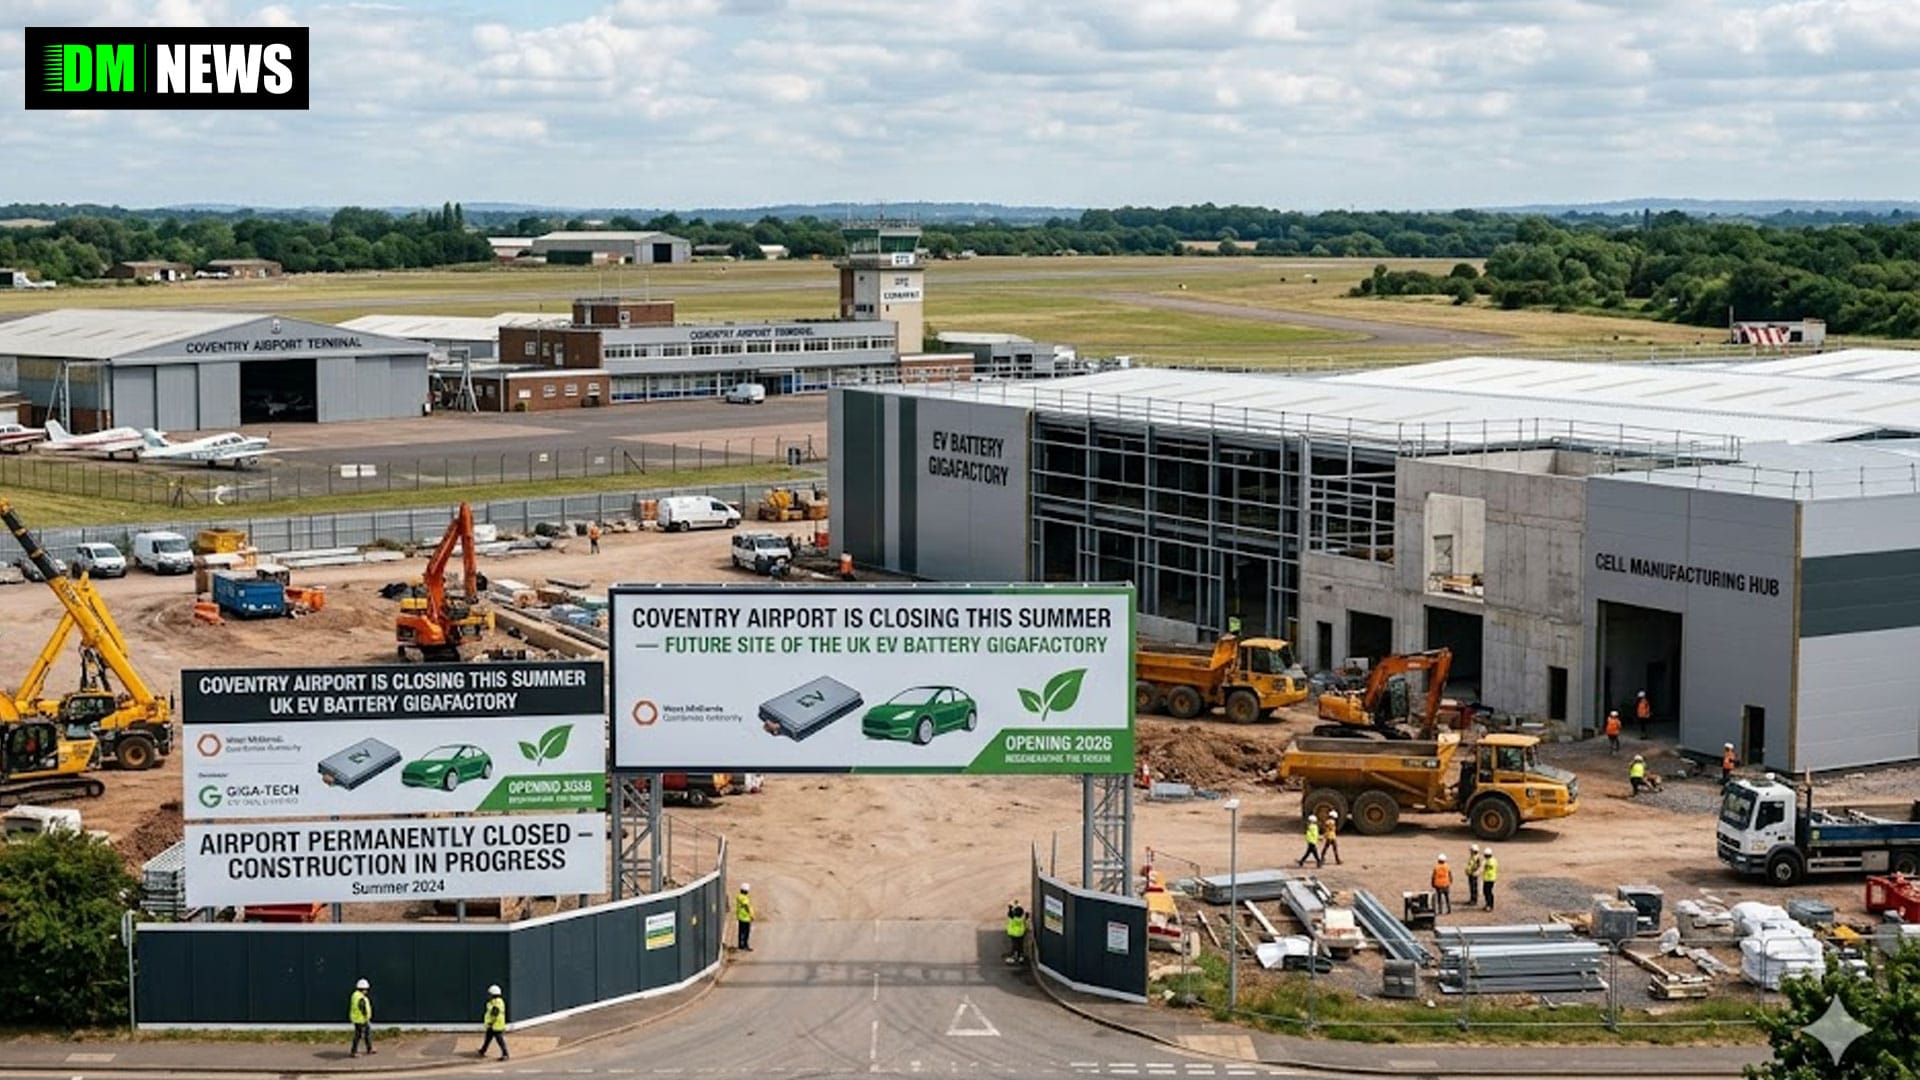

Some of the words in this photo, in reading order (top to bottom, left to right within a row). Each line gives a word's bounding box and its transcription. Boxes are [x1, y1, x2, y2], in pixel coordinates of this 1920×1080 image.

[186, 340, 249, 353] COVENTRY
[933, 431, 948, 451] EV
[951, 433, 1004, 459] BATTERY
[928, 455, 1009, 487] GIGAFACTORY
[1595, 552, 1627, 573] CELL
[1630, 557, 1745, 592] MANUFACTURING
[1749, 574, 1781, 596] HUB
[632, 607, 741, 629] COVENTRY
[746, 607, 838, 628] AIRPORT
[844, 607, 863, 629] IS
[869, 607, 960, 629] CLOSING
[965, 607, 1013, 629] THIS
[1018, 607, 1112, 629] SUMMER
[665, 636, 732, 654] FUTURE
[737, 636, 775, 654] SITE
[781, 636, 803, 654] OF
[808, 636, 842, 654] THE
[847, 636, 871, 654] UK
[876, 636, 898, 654] EV
[903, 636, 981, 654] BATTERY
[986, 636, 1108, 654] GIGAFACTORY
[199, 675, 289, 694] COVENTRY
[293, 673, 367, 692] AIRPORT
[371, 673, 388, 690] IS
[392, 671, 465, 690] CLOSING
[469, 670, 508, 688] THIS
[511, 669, 586, 687] SUMMER
[270, 697, 294, 714] UK
[299, 697, 319, 714] EV
[323, 694, 399, 713] BATTERY
[403, 692, 518, 712] GIGAFACTORY
[1005, 735, 1072, 751] OPENING
[1075, 735, 1113, 751] 2026
[200, 831, 300, 856] AIRPORT
[308, 825, 476, 852] PERMANENTLY
[483, 823, 571, 846] CLOSED
[228, 853, 407, 880] CONSTRUCTION
[415, 853, 437, 874] IN
[445, 848, 567, 873] PROGRESS
[352, 882, 409, 895] Summer
[412, 879, 445, 893] 2024
